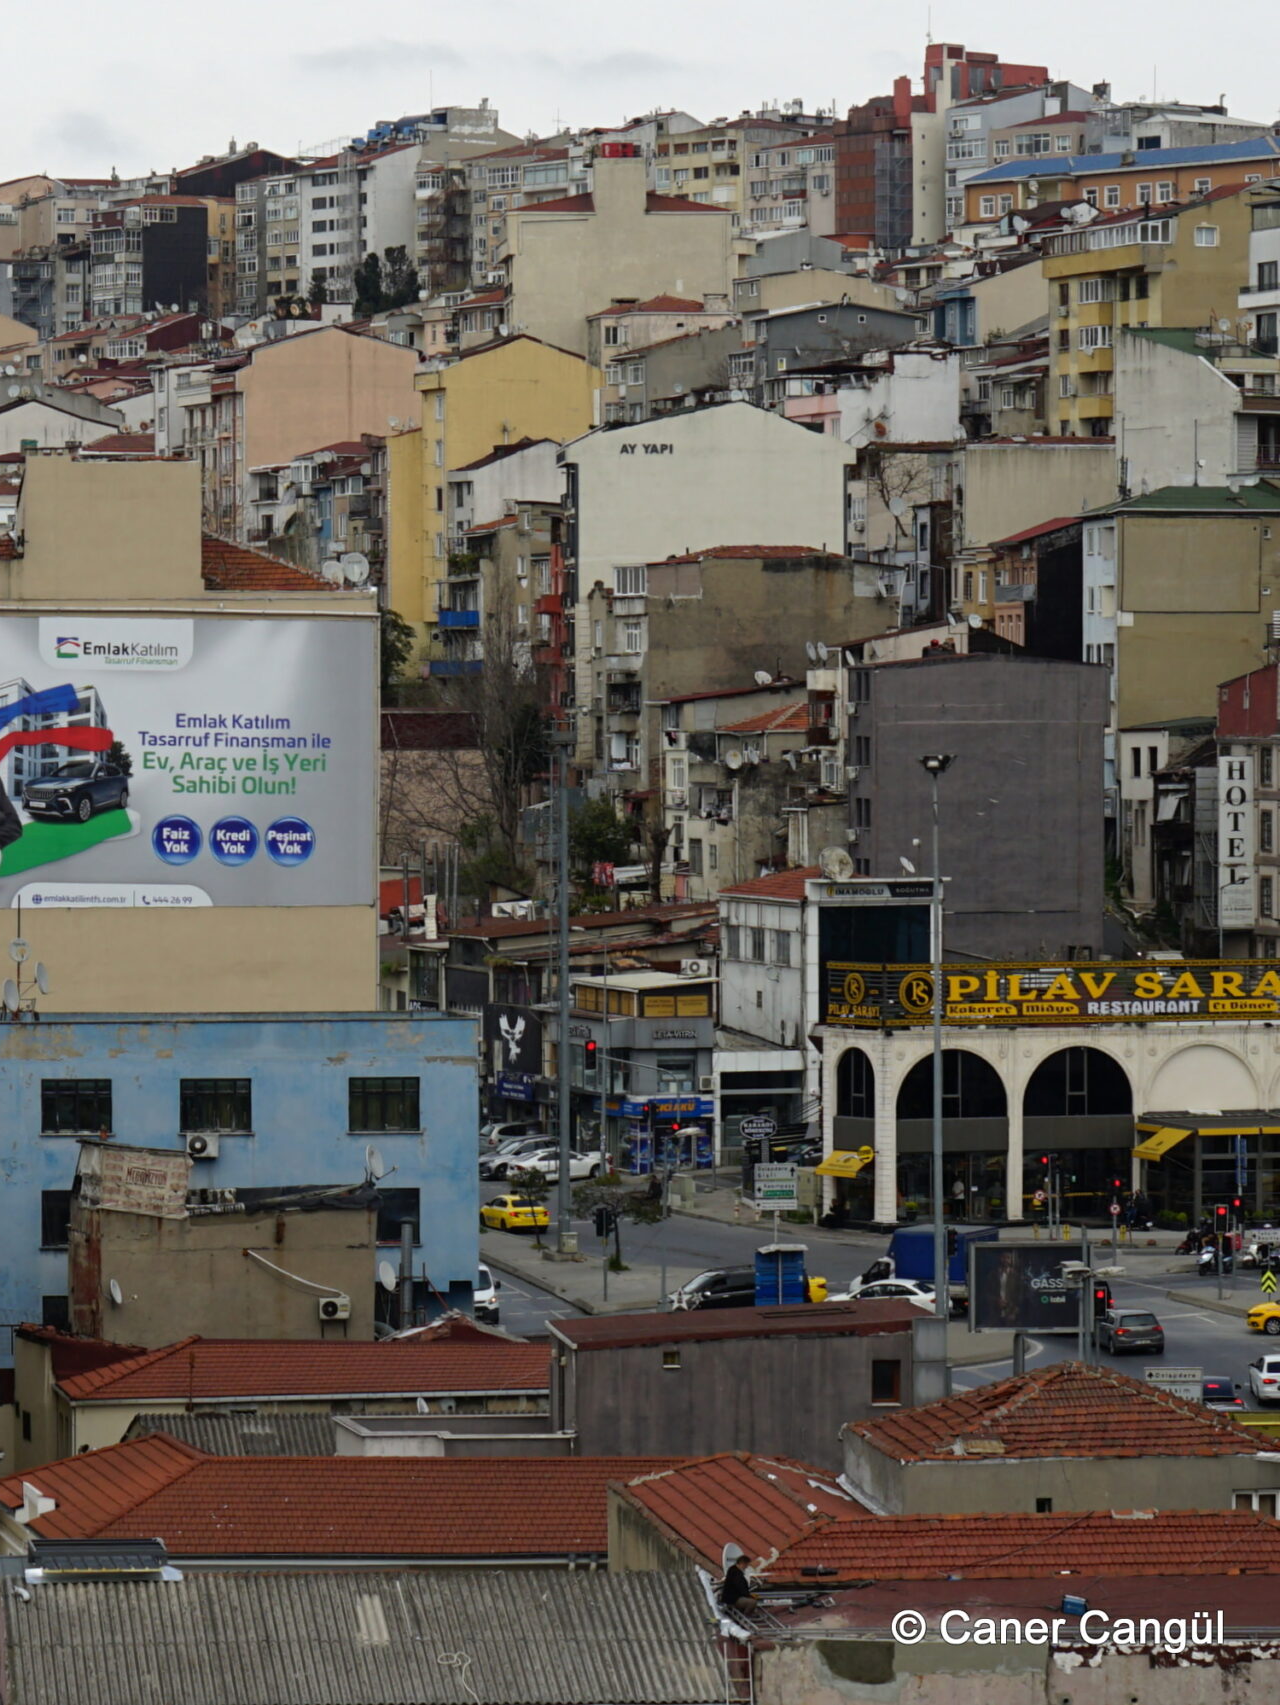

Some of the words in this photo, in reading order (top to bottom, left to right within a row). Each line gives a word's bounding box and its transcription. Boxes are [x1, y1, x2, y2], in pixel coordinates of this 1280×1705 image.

[620, 444, 637, 454] AY
[642, 444, 673, 454] YAPI
[176, 713, 227, 729] Emlak
[232, 714, 290, 730] Katılım
[138, 731, 210, 747] Tasarruf
[214, 732, 307, 748] Finansman
[312, 733, 331, 749] ile
[143, 752, 174, 773] Ev,
[180, 752, 227, 774] Araç
[232, 757, 257, 772] ve
[262, 749, 280, 775] İş
[284, 753, 327, 772] Yeri
[172, 775, 236, 794] Sahibi
[242, 776, 297, 795] Olun!
[1226, 760, 1247, 885] HOTEL
[162, 828, 190, 840] Faiz
[216, 829, 250, 841] Kredi
[268, 830, 312, 843] Peşinat
[164, 841, 189, 853] Yok
[221, 842, 245, 854] Yok
[278, 842, 302, 854] Yok
[946, 970, 1118, 1001] PİLAV
[1025, 1004, 1075, 1015] Midye
[1088, 1000, 1200, 1014] RESTAURANT
[1230, 1001, 1275, 1010] Döner
[1031, 1279, 1064, 1289] GASS
